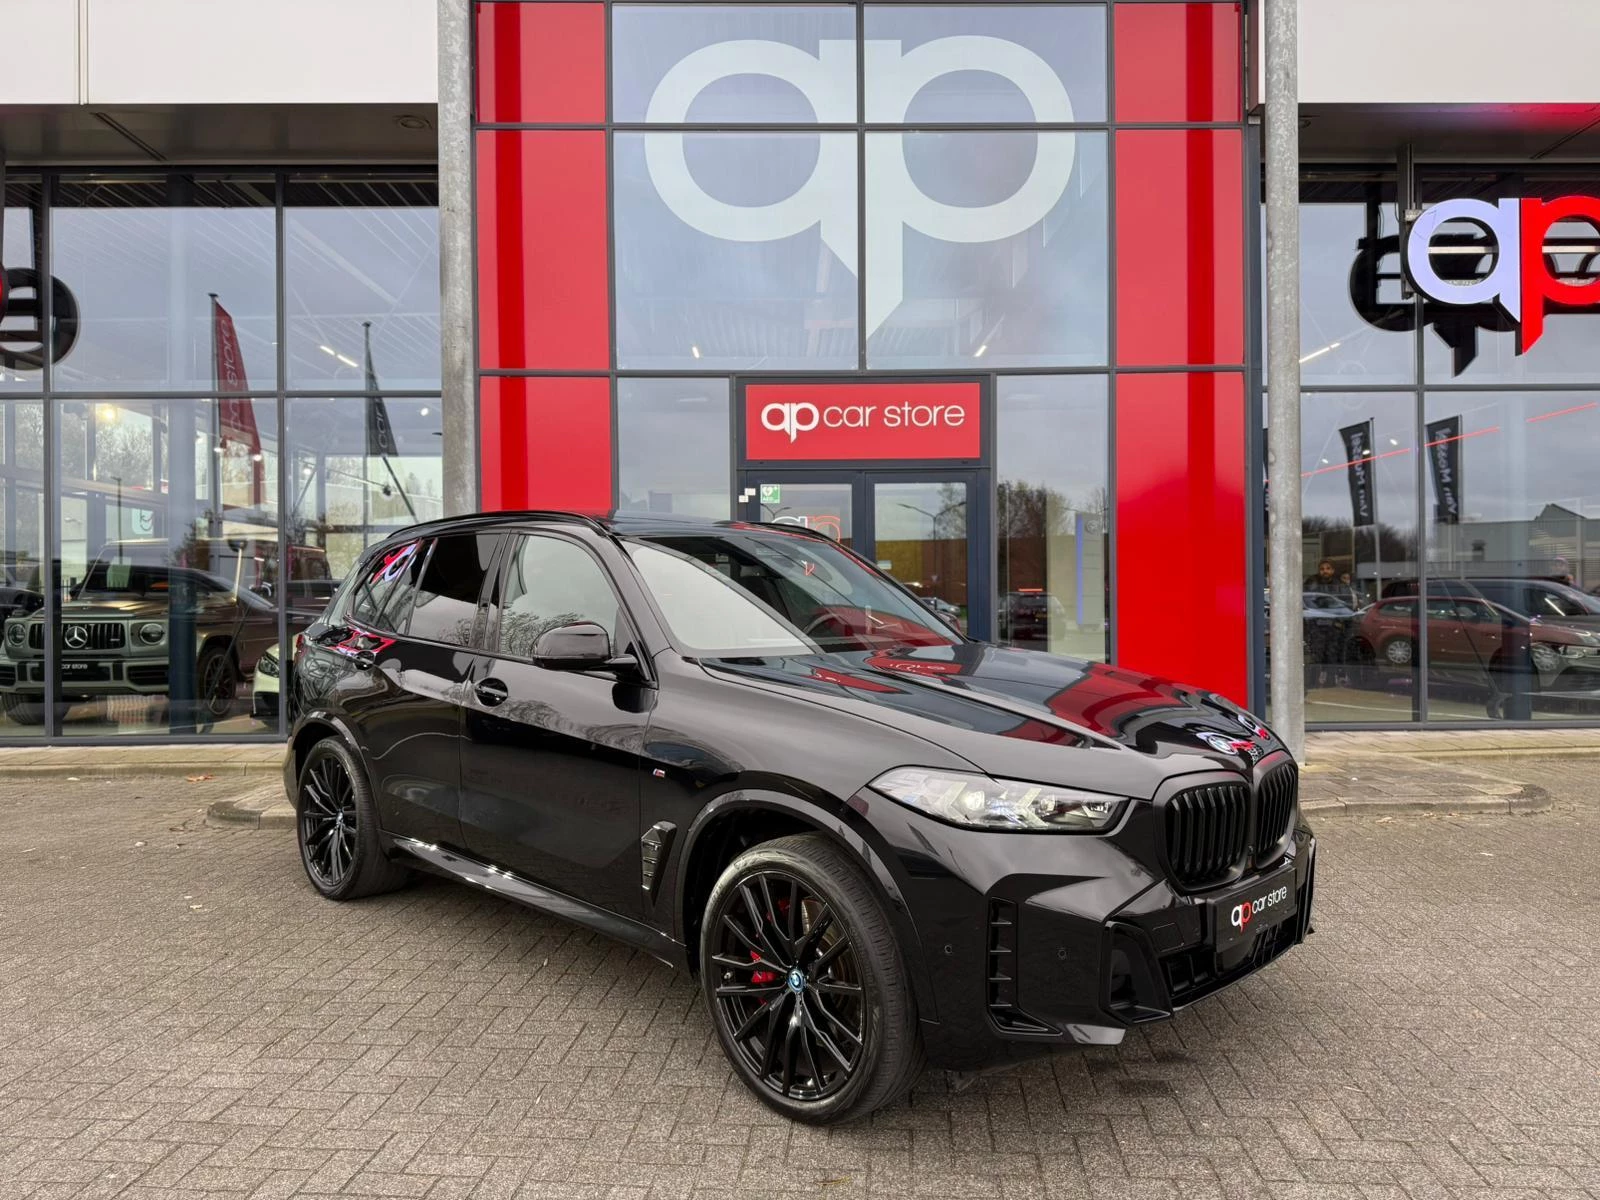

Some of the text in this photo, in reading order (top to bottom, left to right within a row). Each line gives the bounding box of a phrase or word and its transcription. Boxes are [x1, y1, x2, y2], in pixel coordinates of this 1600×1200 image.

[644, 35, 1076, 341] ap
[761, 401, 965, 444] ap car store
[1252, 896, 1267, 914] car
[1267, 886, 1287, 907] store
